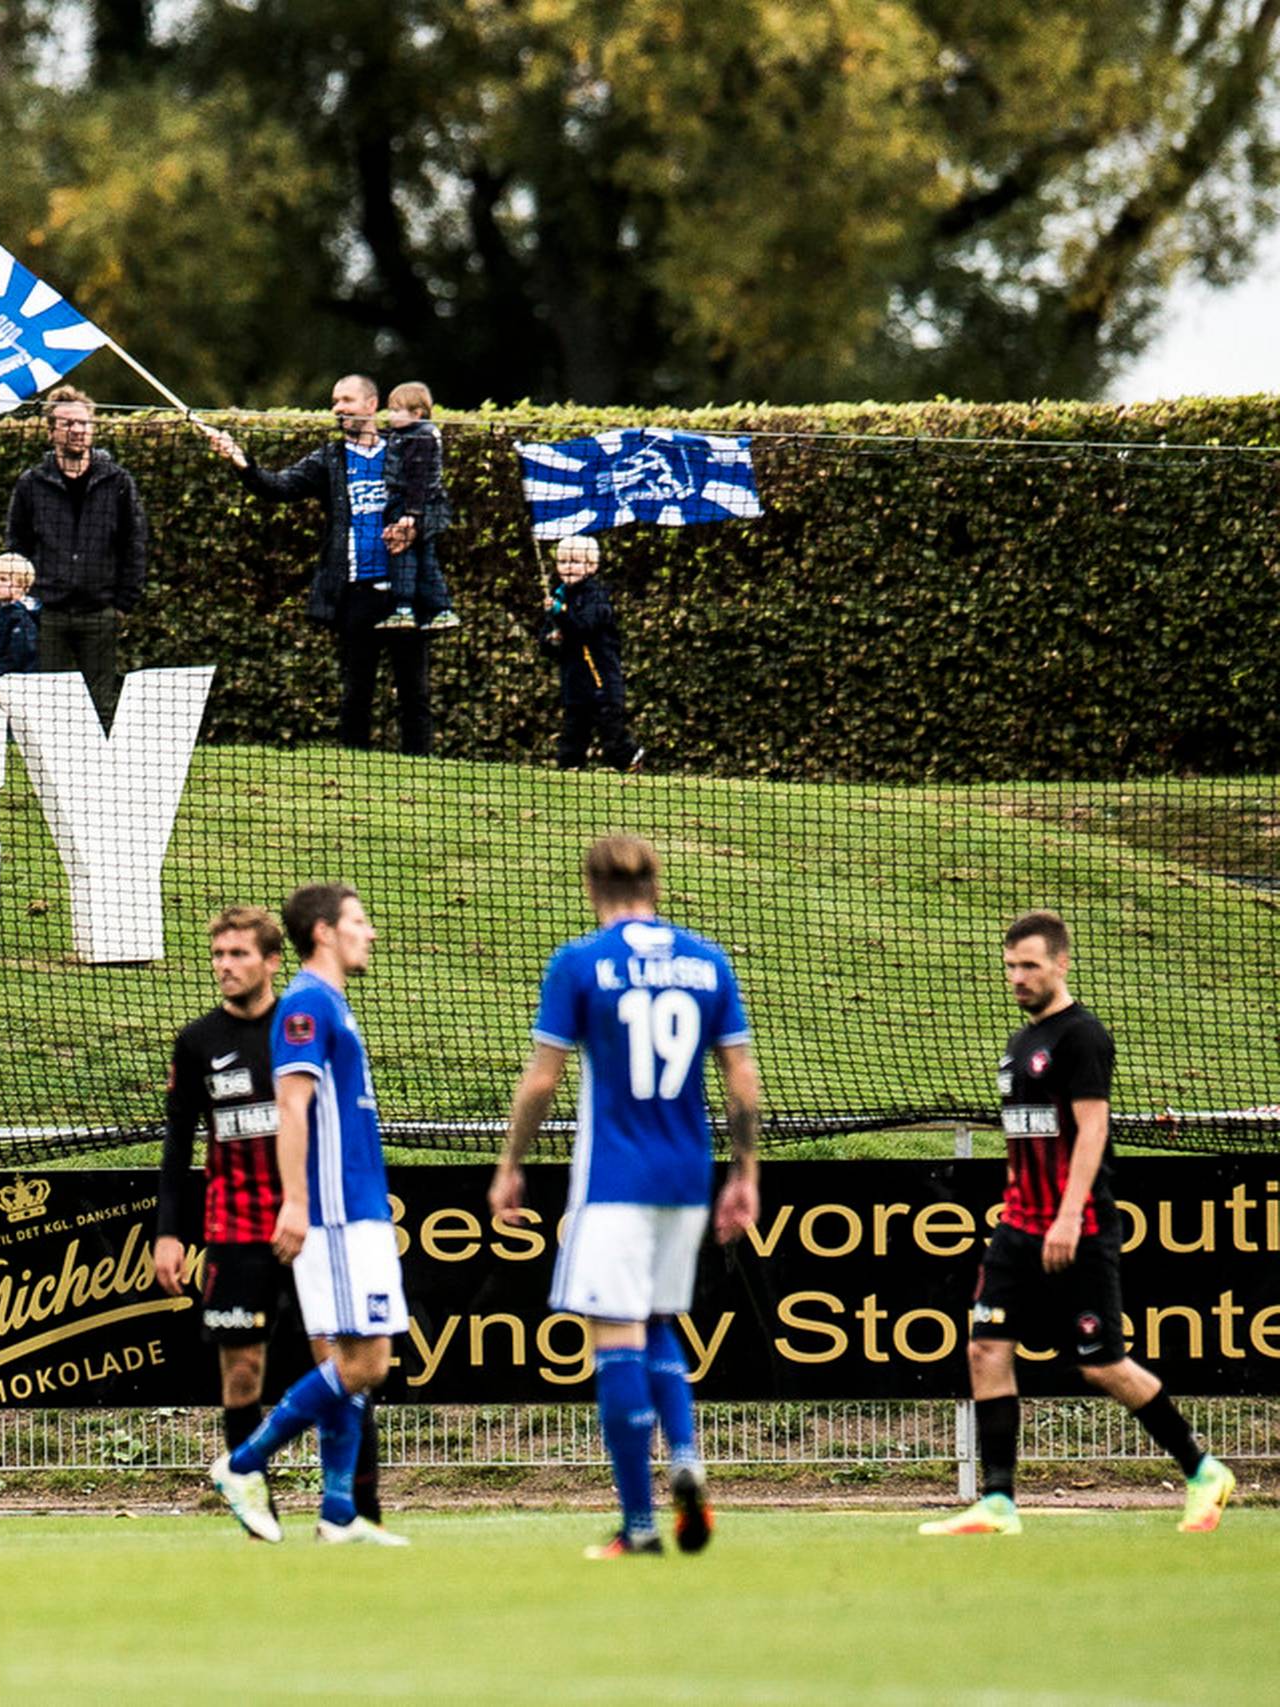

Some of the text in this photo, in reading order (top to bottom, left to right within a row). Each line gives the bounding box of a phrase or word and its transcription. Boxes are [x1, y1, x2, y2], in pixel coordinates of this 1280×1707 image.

[617, 988, 701, 1100] 19
[16, 1228, 41, 1241] DET
[44, 1219, 73, 1236] KGL.
[76, 1203, 128, 1228] DANSKE
[389, 1310, 735, 1387] yngy
